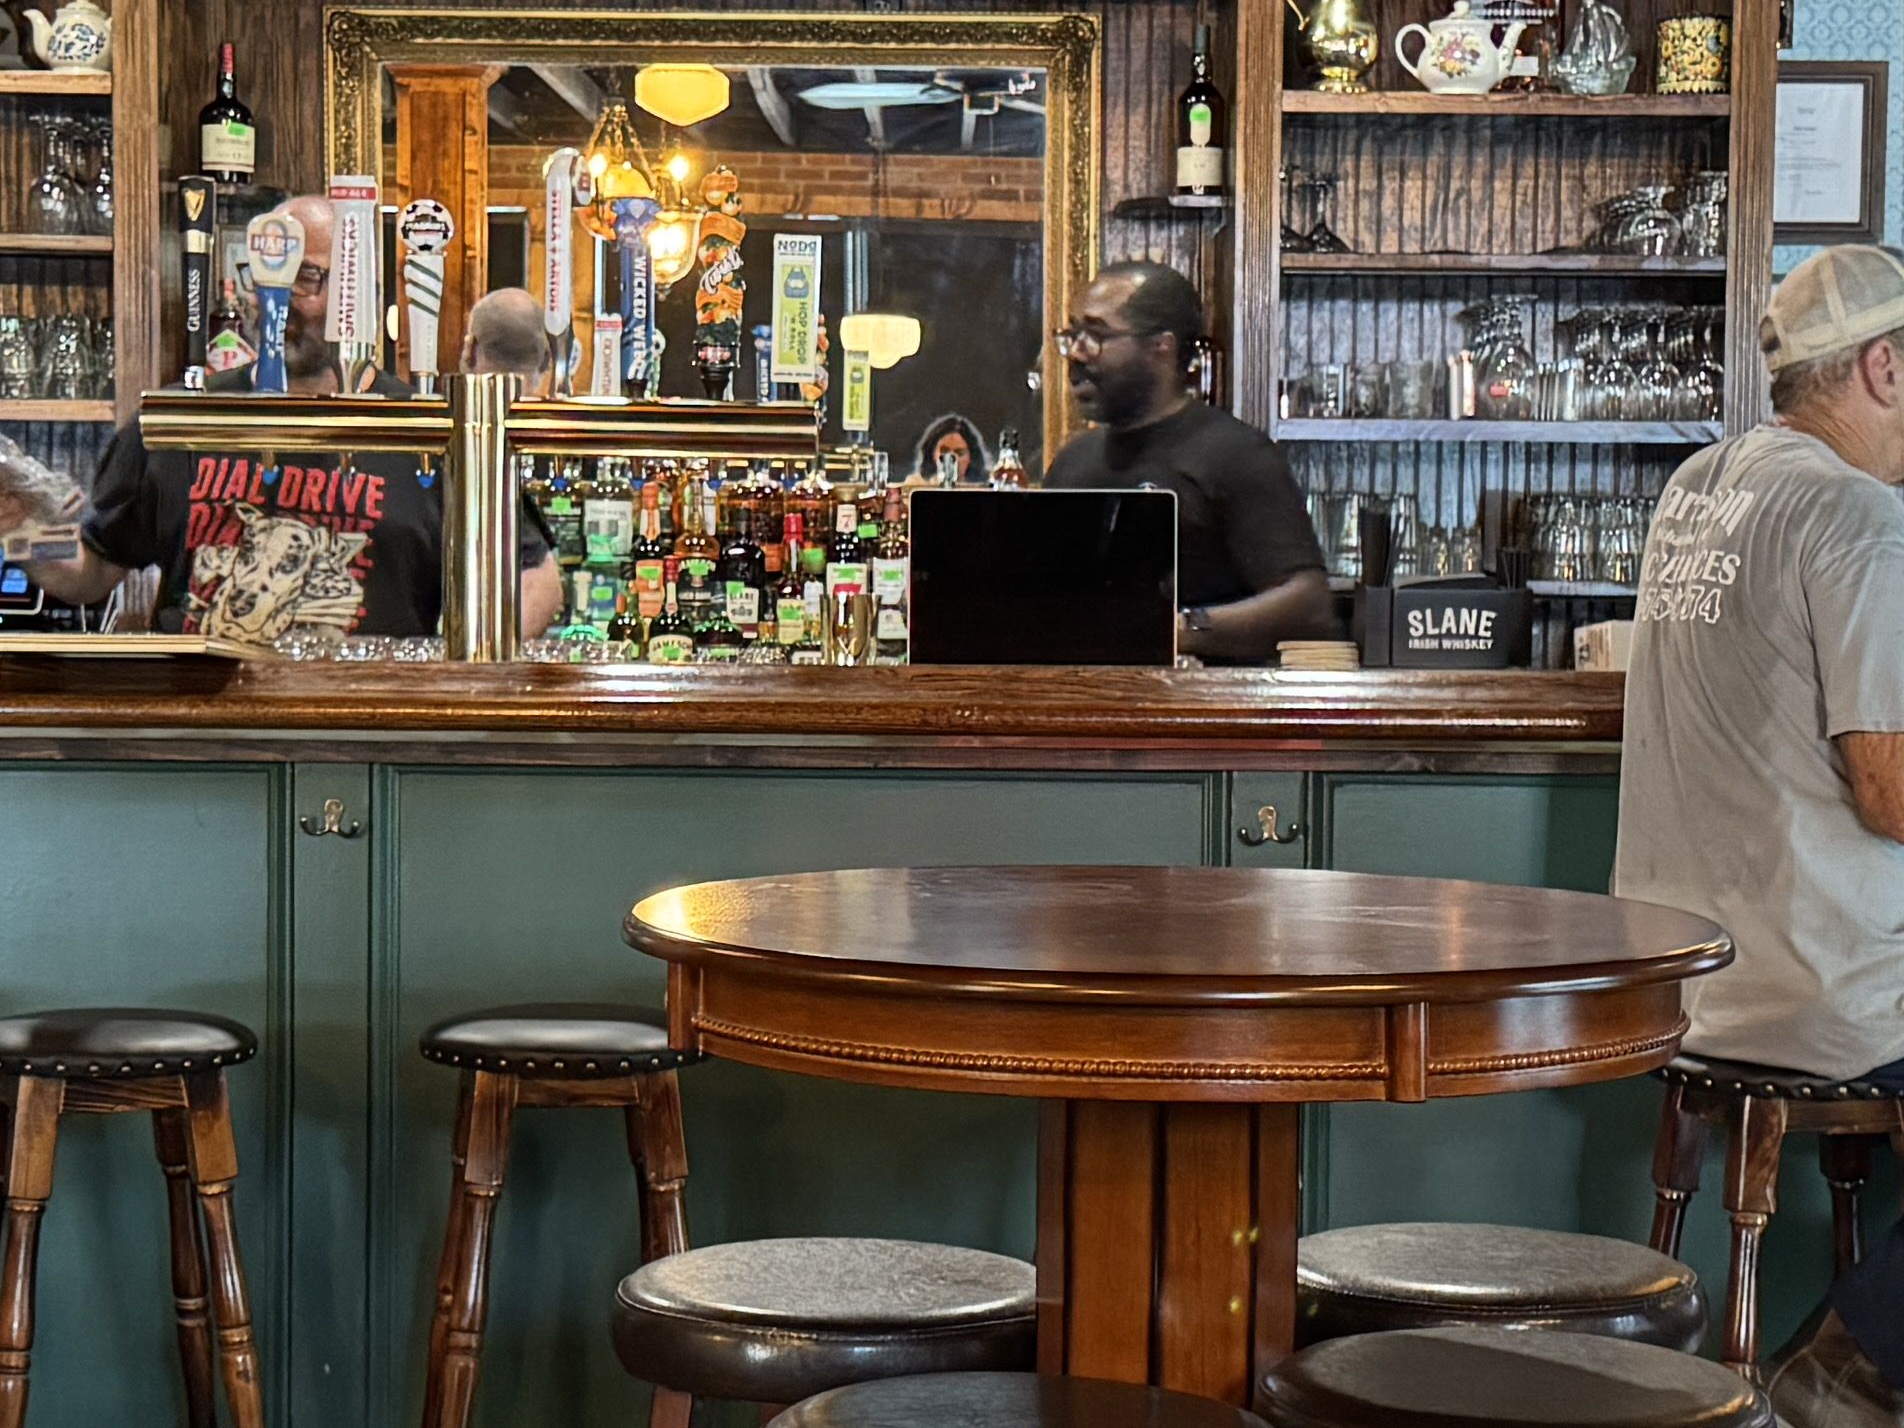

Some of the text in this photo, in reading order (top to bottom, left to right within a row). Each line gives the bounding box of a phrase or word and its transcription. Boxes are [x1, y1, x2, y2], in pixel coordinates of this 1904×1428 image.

[252, 234, 300, 253] HARP
[187, 269, 200, 332] GUINNESS
[633, 256, 647, 319] WICKED
[797, 301, 807, 364] HOP DROP
[188, 457, 386, 520] DIAL DRIVE
[1407, 607, 1498, 637] SLANE
[1408, 638, 1494, 650] IRISH WHISKEY
